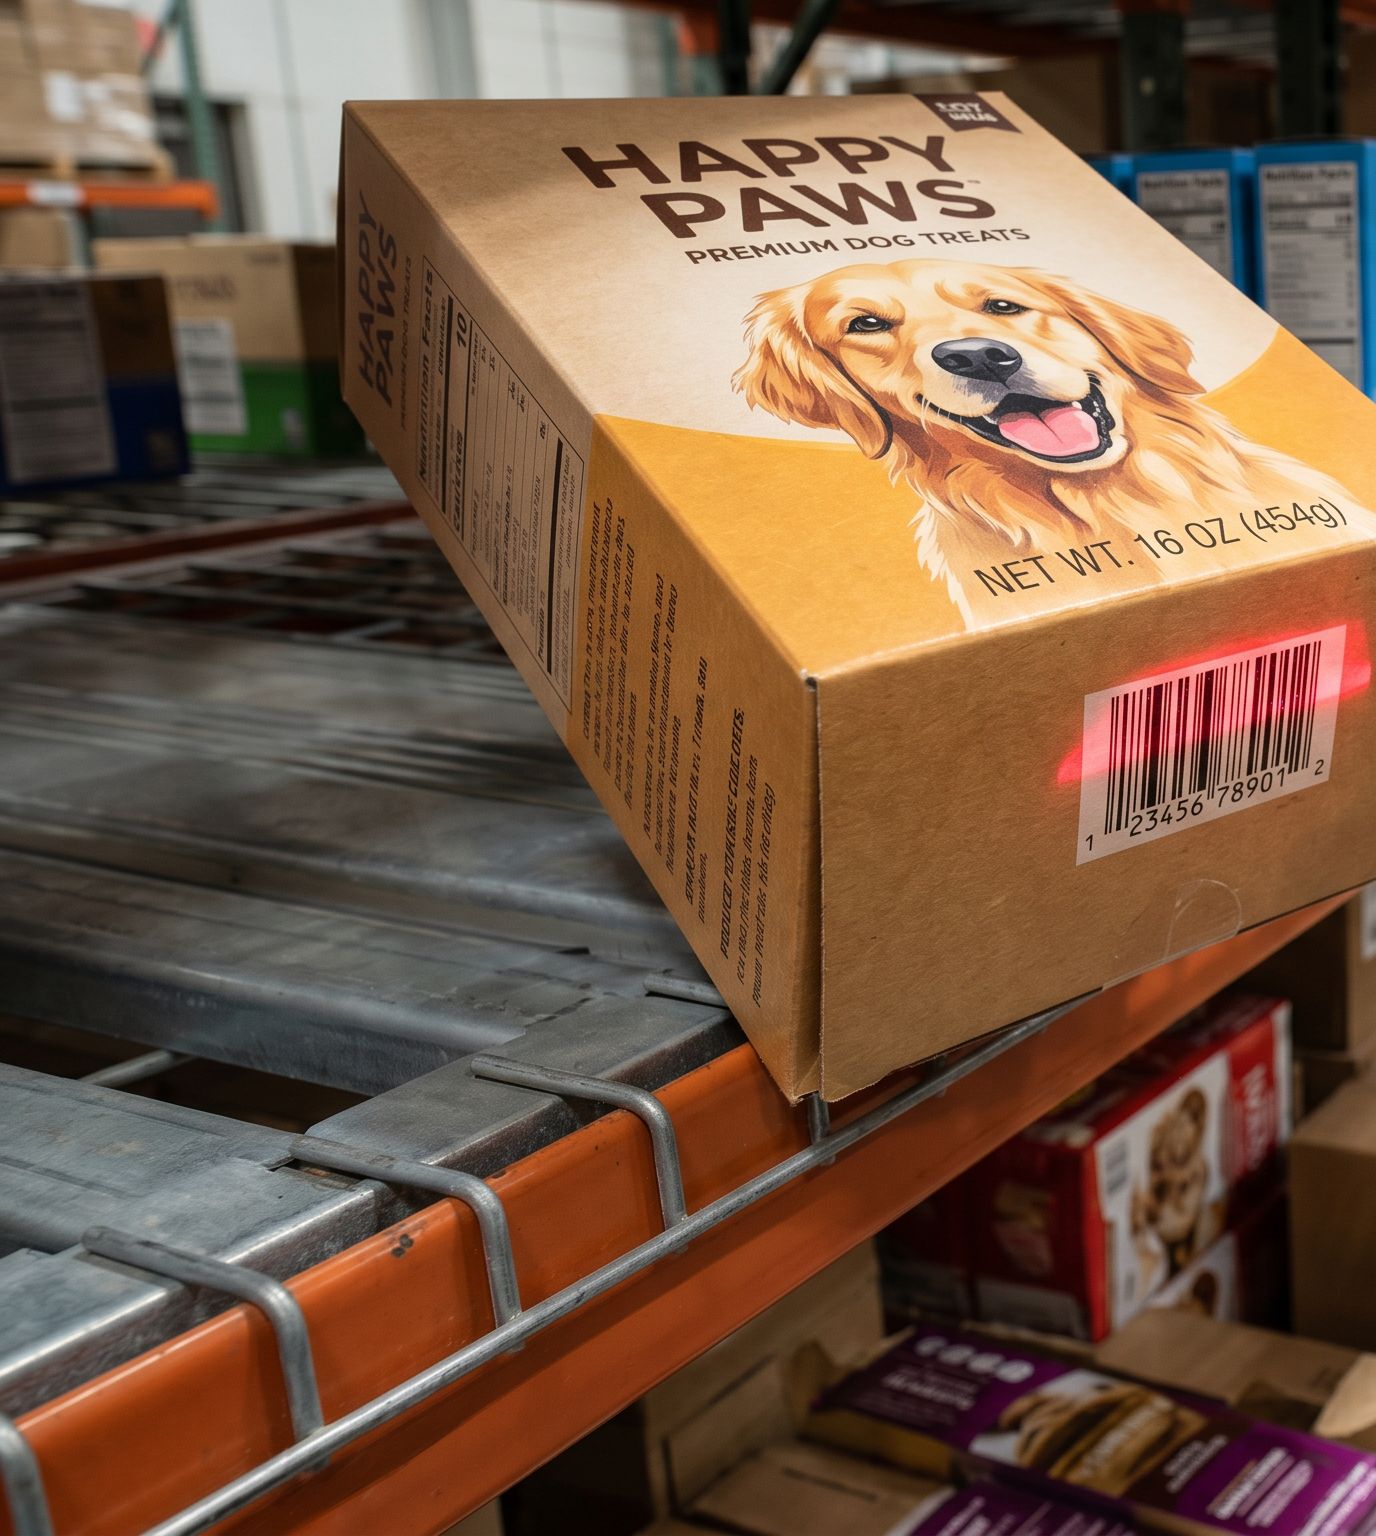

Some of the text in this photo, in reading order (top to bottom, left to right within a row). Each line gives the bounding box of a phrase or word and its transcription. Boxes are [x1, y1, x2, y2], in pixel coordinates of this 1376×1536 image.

[561, 136, 956, 189] HAPPY
[640, 179, 995, 239] PAWS
[684, 228, 1031, 264] PREMIUM DOG TREATS
[357, 190, 379, 389] HAPPY
[376, 223, 397, 408] PAWS
[455, 307, 467, 355] 10
[973, 496, 1348, 597] NET WT. 16 OZ (454g)
[1085, 759, 1324, 851] 1 23456 78901 2
